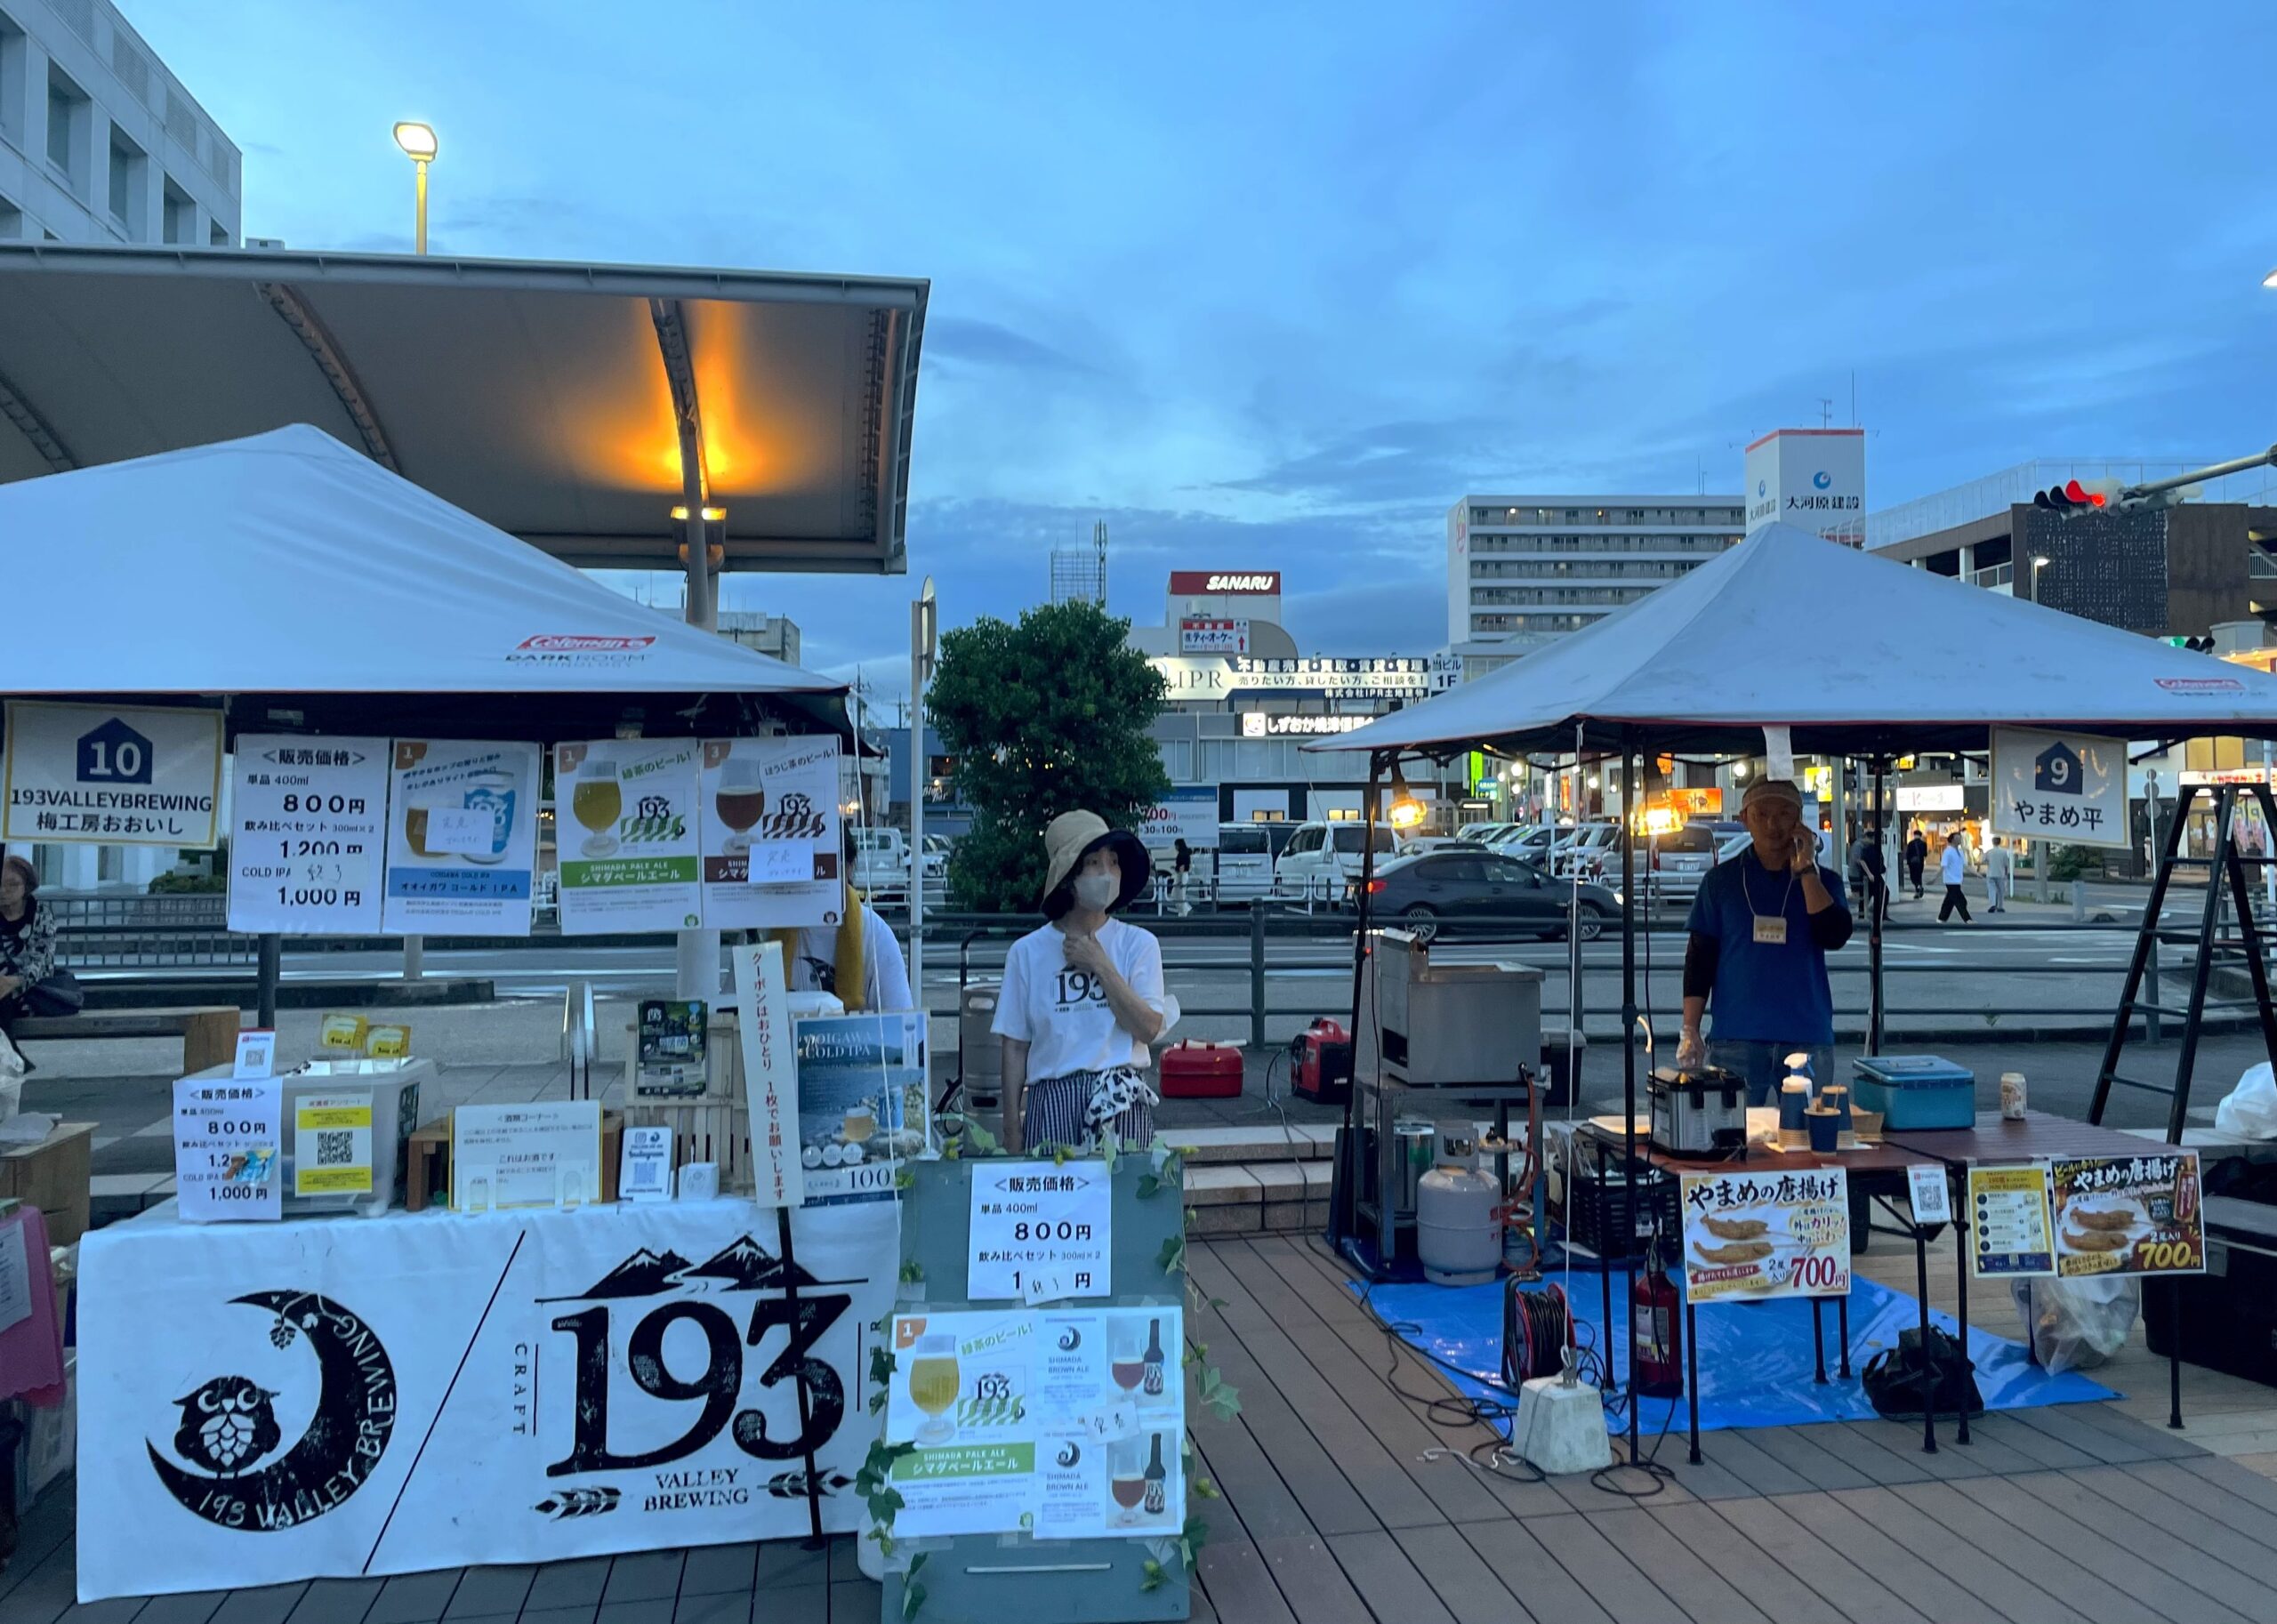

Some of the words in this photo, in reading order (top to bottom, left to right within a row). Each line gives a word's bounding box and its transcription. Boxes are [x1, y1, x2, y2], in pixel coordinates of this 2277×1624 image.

[1786, 496, 1860, 510] 大河原建設
[1206, 575, 1273, 591] SANARU
[1179, 670, 1223, 689] IPR
[1437, 675, 1457, 687] 1F
[1267, 716, 1373, 735] しずおか焼津信用
[90, 741, 141, 777] 10
[247, 775, 270, 785] 単品
[275, 776, 310, 785] 400ml
[2050, 757, 2070, 786] 9
[12, 789, 213, 812] 193VALLEYBREWING
[283, 794, 366, 815] 800円
[638, 800, 671, 820] 193
[779, 798, 811, 816] 193
[36, 811, 183, 835] 梅工房おおいし
[245, 820, 327, 832] 飲み比べセット
[2015, 800, 2104, 832] やまめ平
[242, 867, 272, 878] COLD
[278, 886, 337, 906] 1,000
[752, 952, 771, 1072] クーポンはおひとり
[805, 1046, 844, 1058] COLD
[849, 1044, 871, 1057] IPA
[208, 1121, 266, 1135] 800円
[2073, 1156, 2179, 1192] やまめの唐揚げ
[210, 1186, 252, 1202] 1,000
[1688, 1173, 1839, 1210] やまめの唐揚げ
[981, 1203, 1002, 1215] 単品
[1006, 1202, 1038, 1215] 400ml
[1014, 1221, 1091, 1241] 800円
[978, 1249, 1057, 1263] 飲み比べセット
[1075, 1272, 1090, 1289] 円
[1791, 1256, 1847, 1289] 700円
[903, 1323, 913, 1338] 1
[513, 1342, 528, 1435] CRAFT
[546, 1293, 852, 1477] 193
[977, 1379, 1010, 1401] 193
[255, 1457, 360, 1530] VALLEY
[333, 1314, 395, 1459] BREWING
[655, 1467, 739, 1489] VALLEY
[1046, 1483, 1074, 1491] BROWN
[643, 1487, 750, 1511] BREWING
